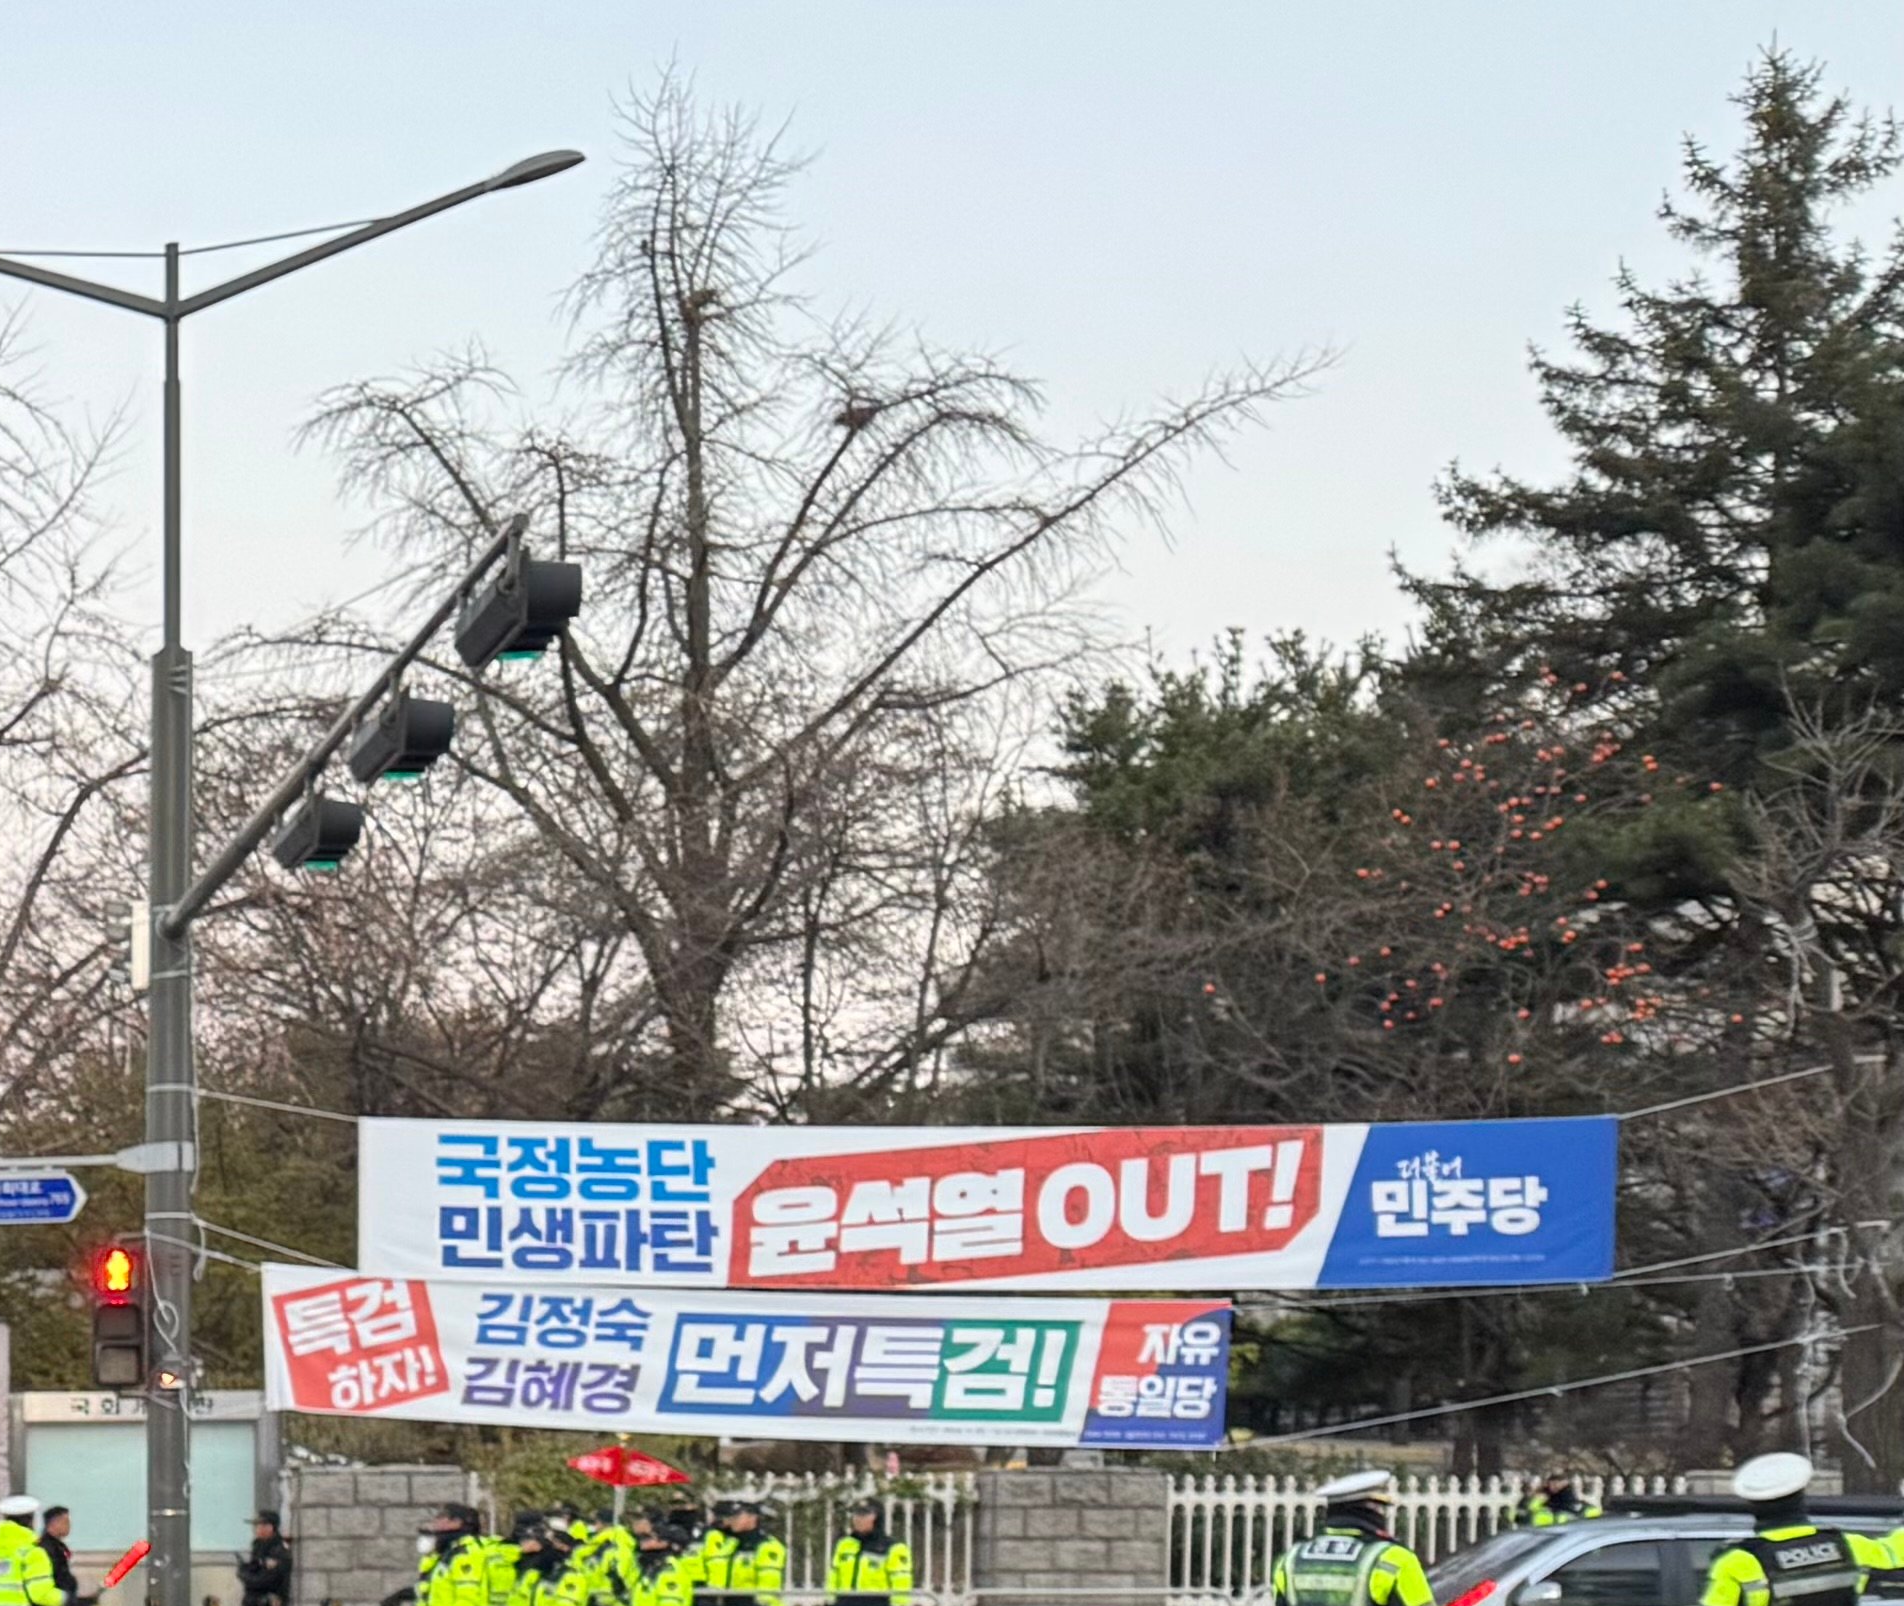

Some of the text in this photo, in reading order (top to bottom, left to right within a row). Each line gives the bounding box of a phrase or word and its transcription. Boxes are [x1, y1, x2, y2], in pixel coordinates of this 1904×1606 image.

[436, 1134, 716, 1203] 국정농단
[748, 1139, 1305, 1277] 윤석열 OUT!
[1371, 1175, 1549, 1238] 민주당
[439, 1206, 719, 1273] 민생파탄
[283, 1279, 417, 1358] 특검
[475, 1293, 653, 1351] 김정숙
[1137, 1321, 1223, 1367] 자유
[327, 1345, 437, 1410] 하자!
[460, 1357, 642, 1415] 김혜경
[672, 1321, 1068, 1409] 먼저특검!
[1096, 1374, 1217, 1420] 통일당
[1774, 1542, 1842, 1569] POLICE
